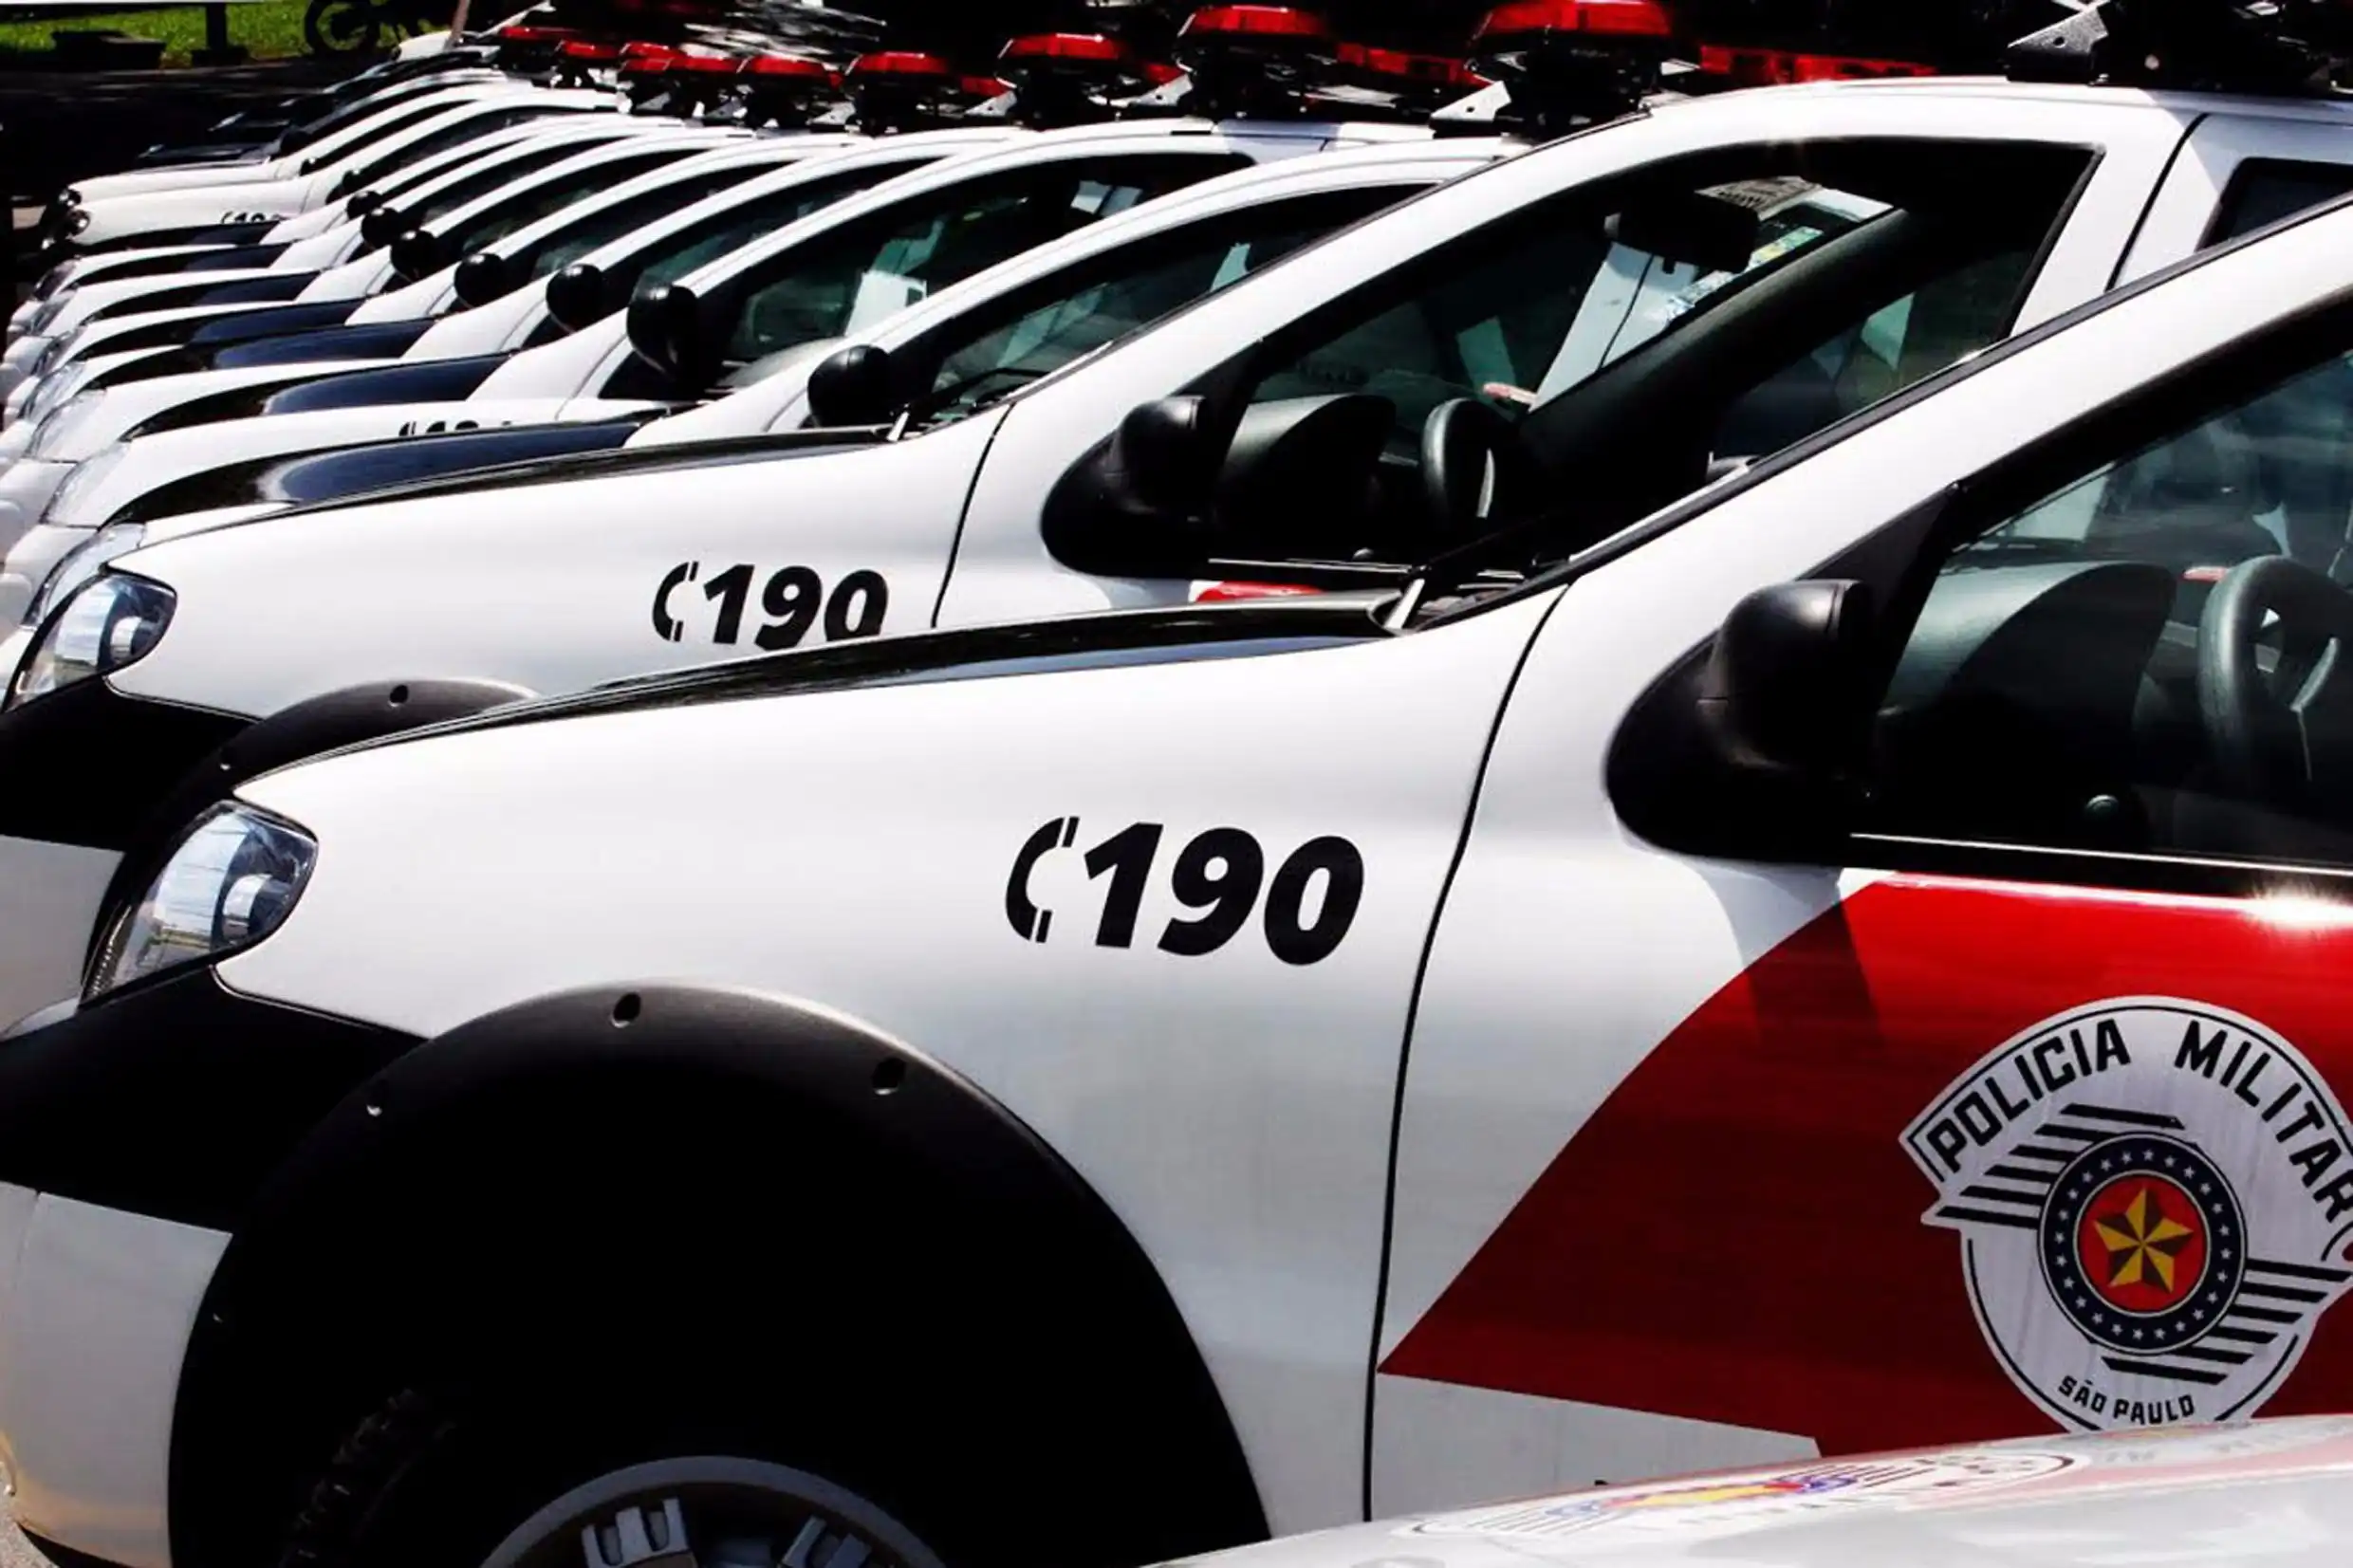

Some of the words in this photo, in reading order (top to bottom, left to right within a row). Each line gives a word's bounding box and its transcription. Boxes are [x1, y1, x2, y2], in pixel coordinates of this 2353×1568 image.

[703, 564, 888, 652] 190
[1084, 822, 1364, 966] 190
[1925, 1018, 2132, 1174] POLICIA
[2174, 1019, 2353, 1224] MILITAR
[2058, 1374, 2108, 1415] SÃO
[2112, 1393, 2196, 1426] PAULO
